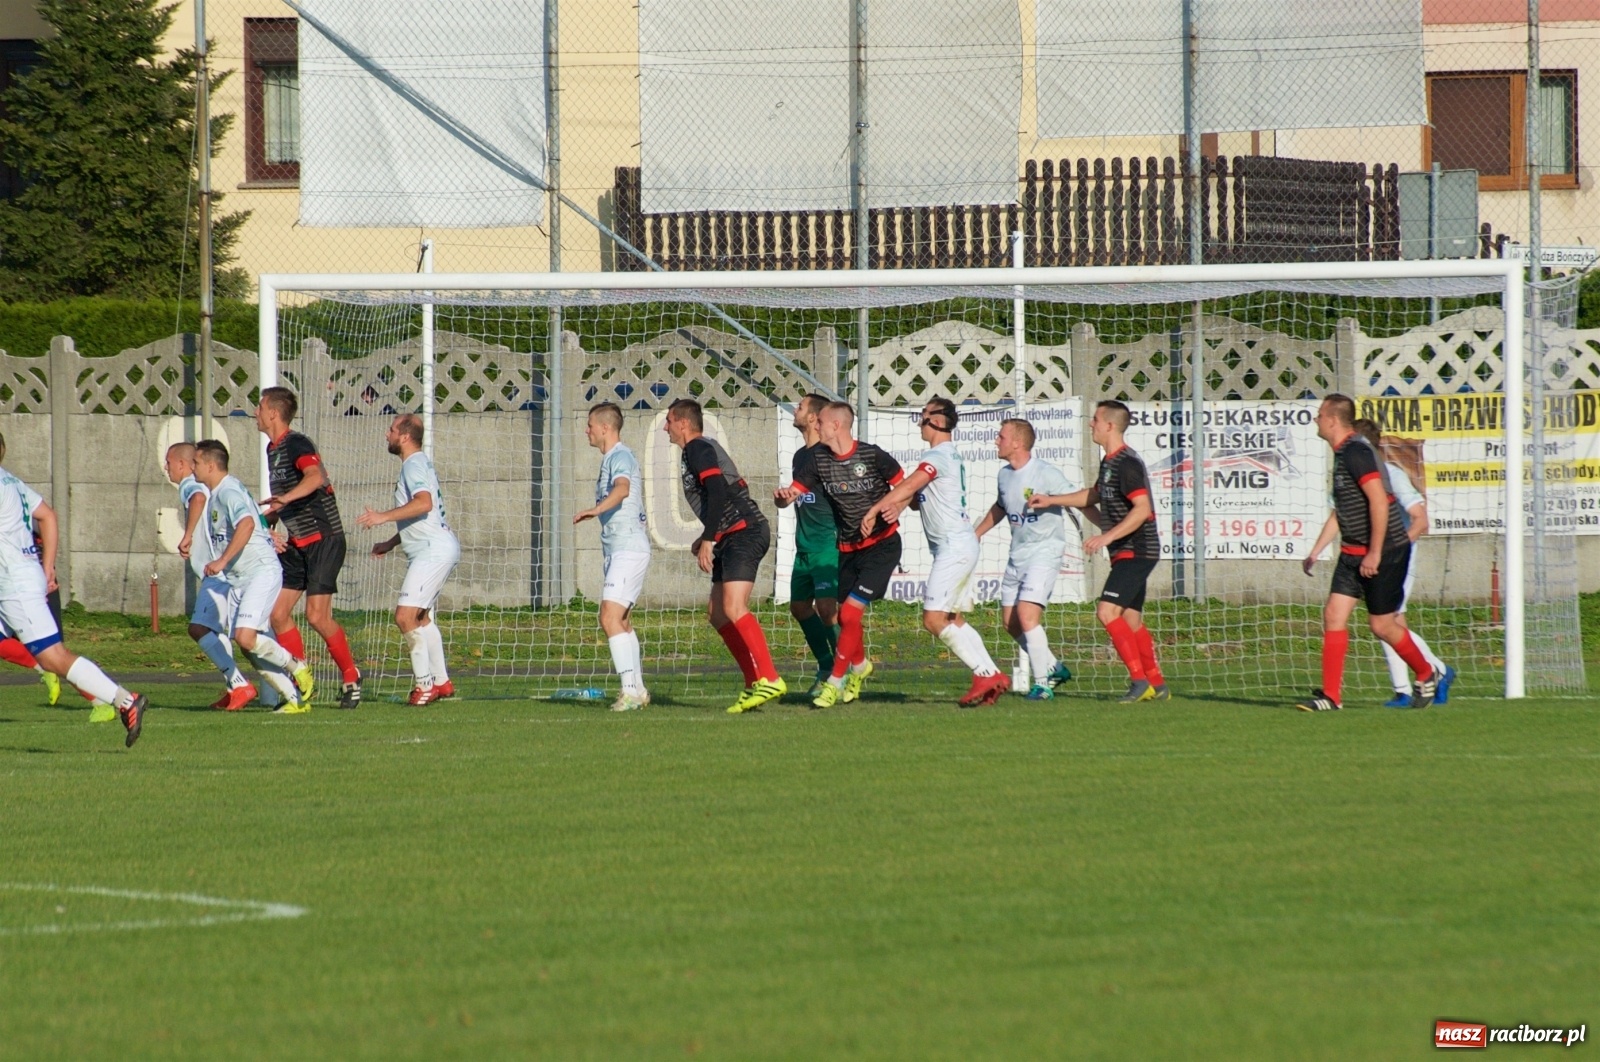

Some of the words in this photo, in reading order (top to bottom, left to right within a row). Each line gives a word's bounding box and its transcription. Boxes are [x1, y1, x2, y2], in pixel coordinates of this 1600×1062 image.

[1130, 410, 1190, 426] SŁUGI
[1581, 498, 1595, 509] 62
[1219, 520, 1257, 537] 196
[1264, 520, 1303, 537] 012
[1217, 542, 1234, 554] ul.
[1240, 543, 1280, 554] Nowa
[1285, 542, 1294, 554] 8
